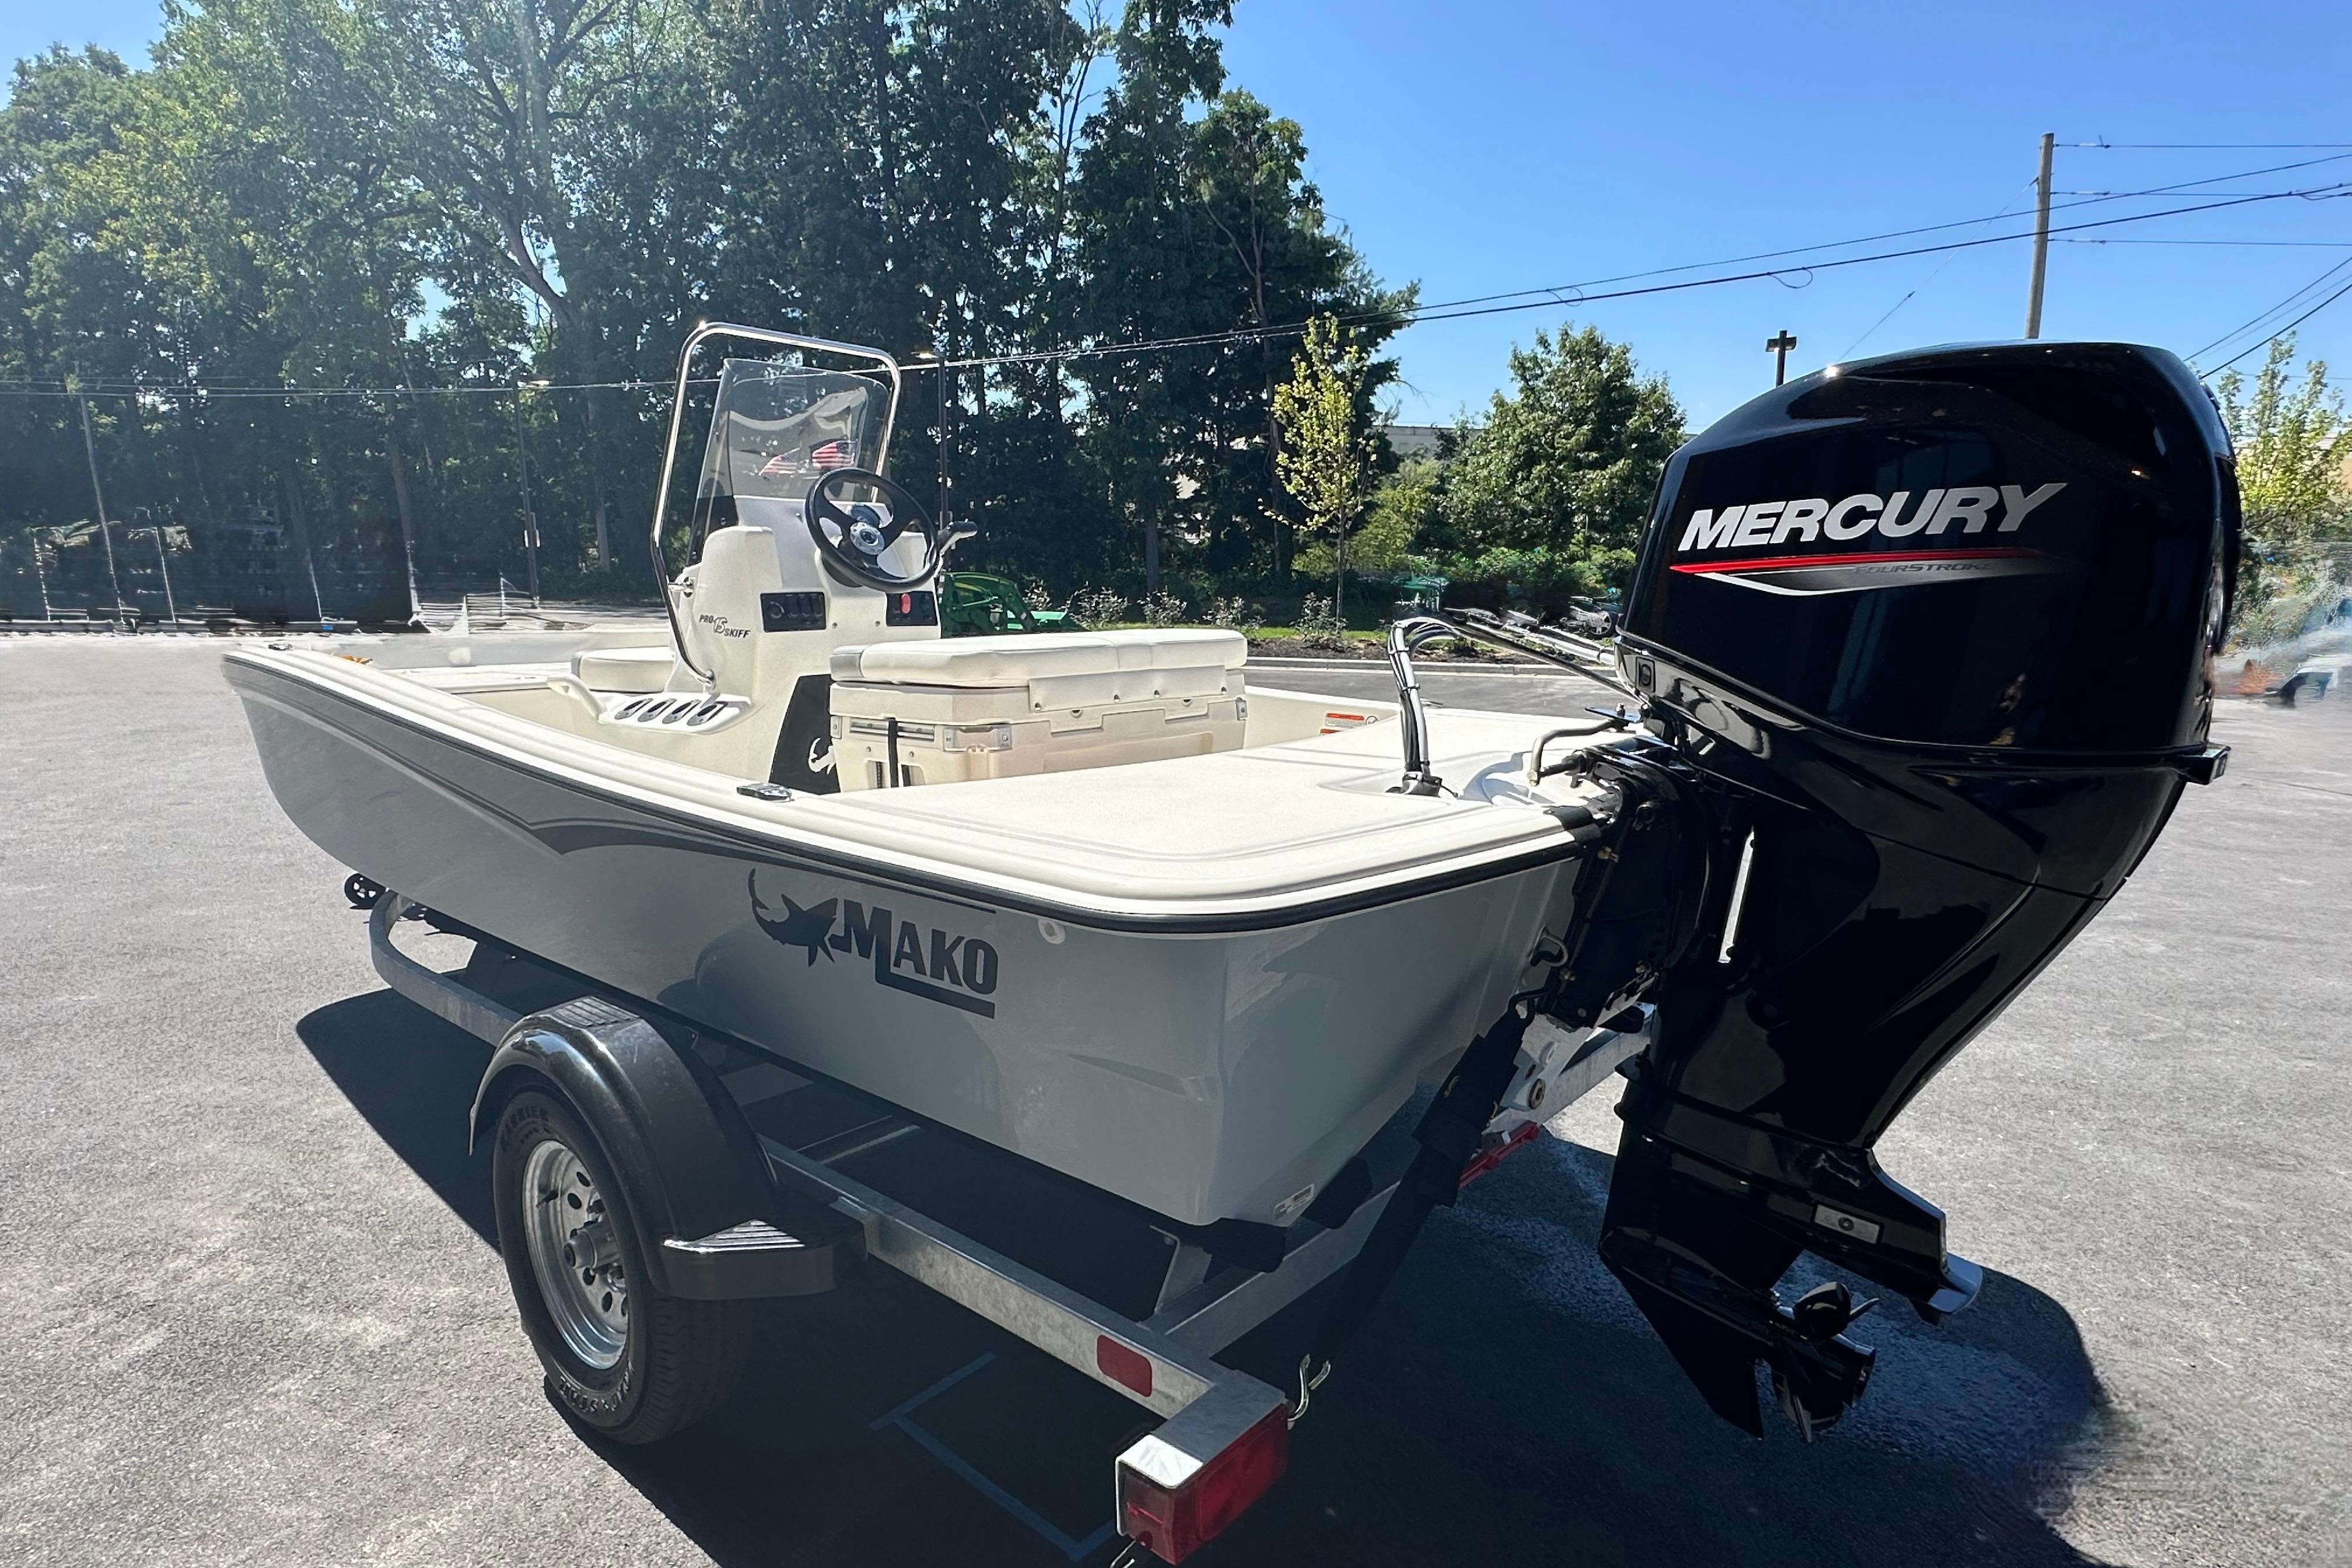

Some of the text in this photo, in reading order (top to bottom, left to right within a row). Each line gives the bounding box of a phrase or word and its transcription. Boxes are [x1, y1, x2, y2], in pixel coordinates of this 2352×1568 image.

[1678, 482, 2068, 552] MERCURY
[699, 614, 713, 624] PRO
[724, 628, 751, 639] SKIFF
[828, 899, 999, 1019] MAKO
